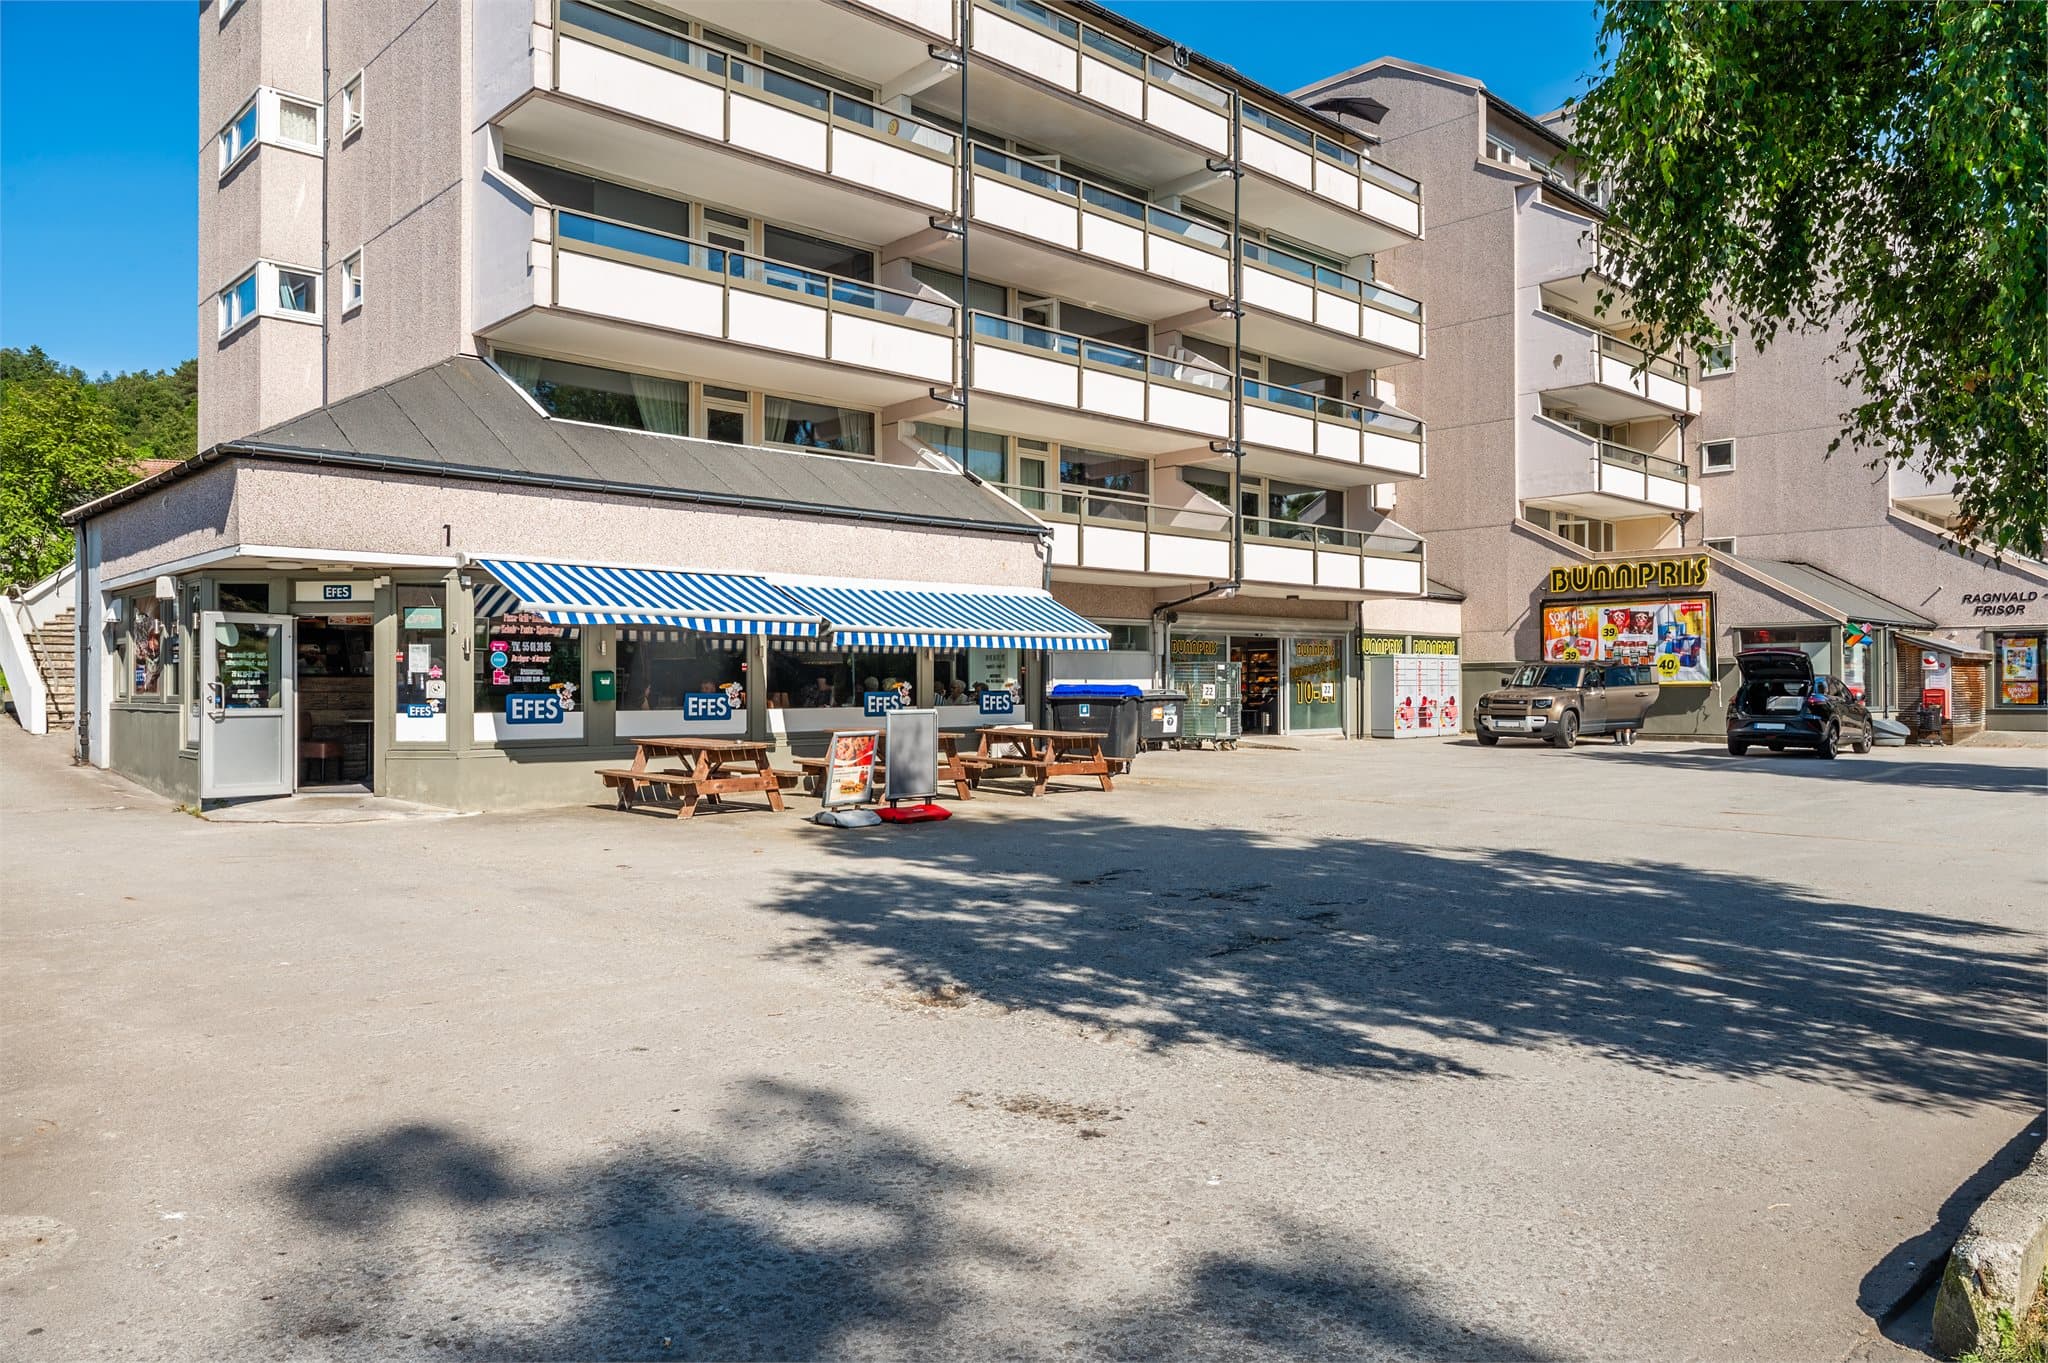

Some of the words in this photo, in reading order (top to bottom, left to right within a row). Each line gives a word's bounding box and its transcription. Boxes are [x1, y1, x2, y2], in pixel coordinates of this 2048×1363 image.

[442, 524, 451, 547] 1
[1550, 557, 1710, 593] BUNNPRIS
[326, 586, 349, 598] EFES
[1961, 591, 2038, 604] RAGNVALD
[1974, 604, 2026, 616] FRISØR
[1171, 639, 1217, 655] BUNNPRIS
[1296, 643, 1335, 657] BUNNPRIS
[1205, 687, 1213, 696] 22
[1323, 685, 1331, 694] 22
[512, 697, 558, 720] EFES
[688, 697, 727, 716] EFES
[868, 695, 899, 712] EFES
[982, 694, 1010, 711] EFES
[410, 705, 431, 717] EFES
